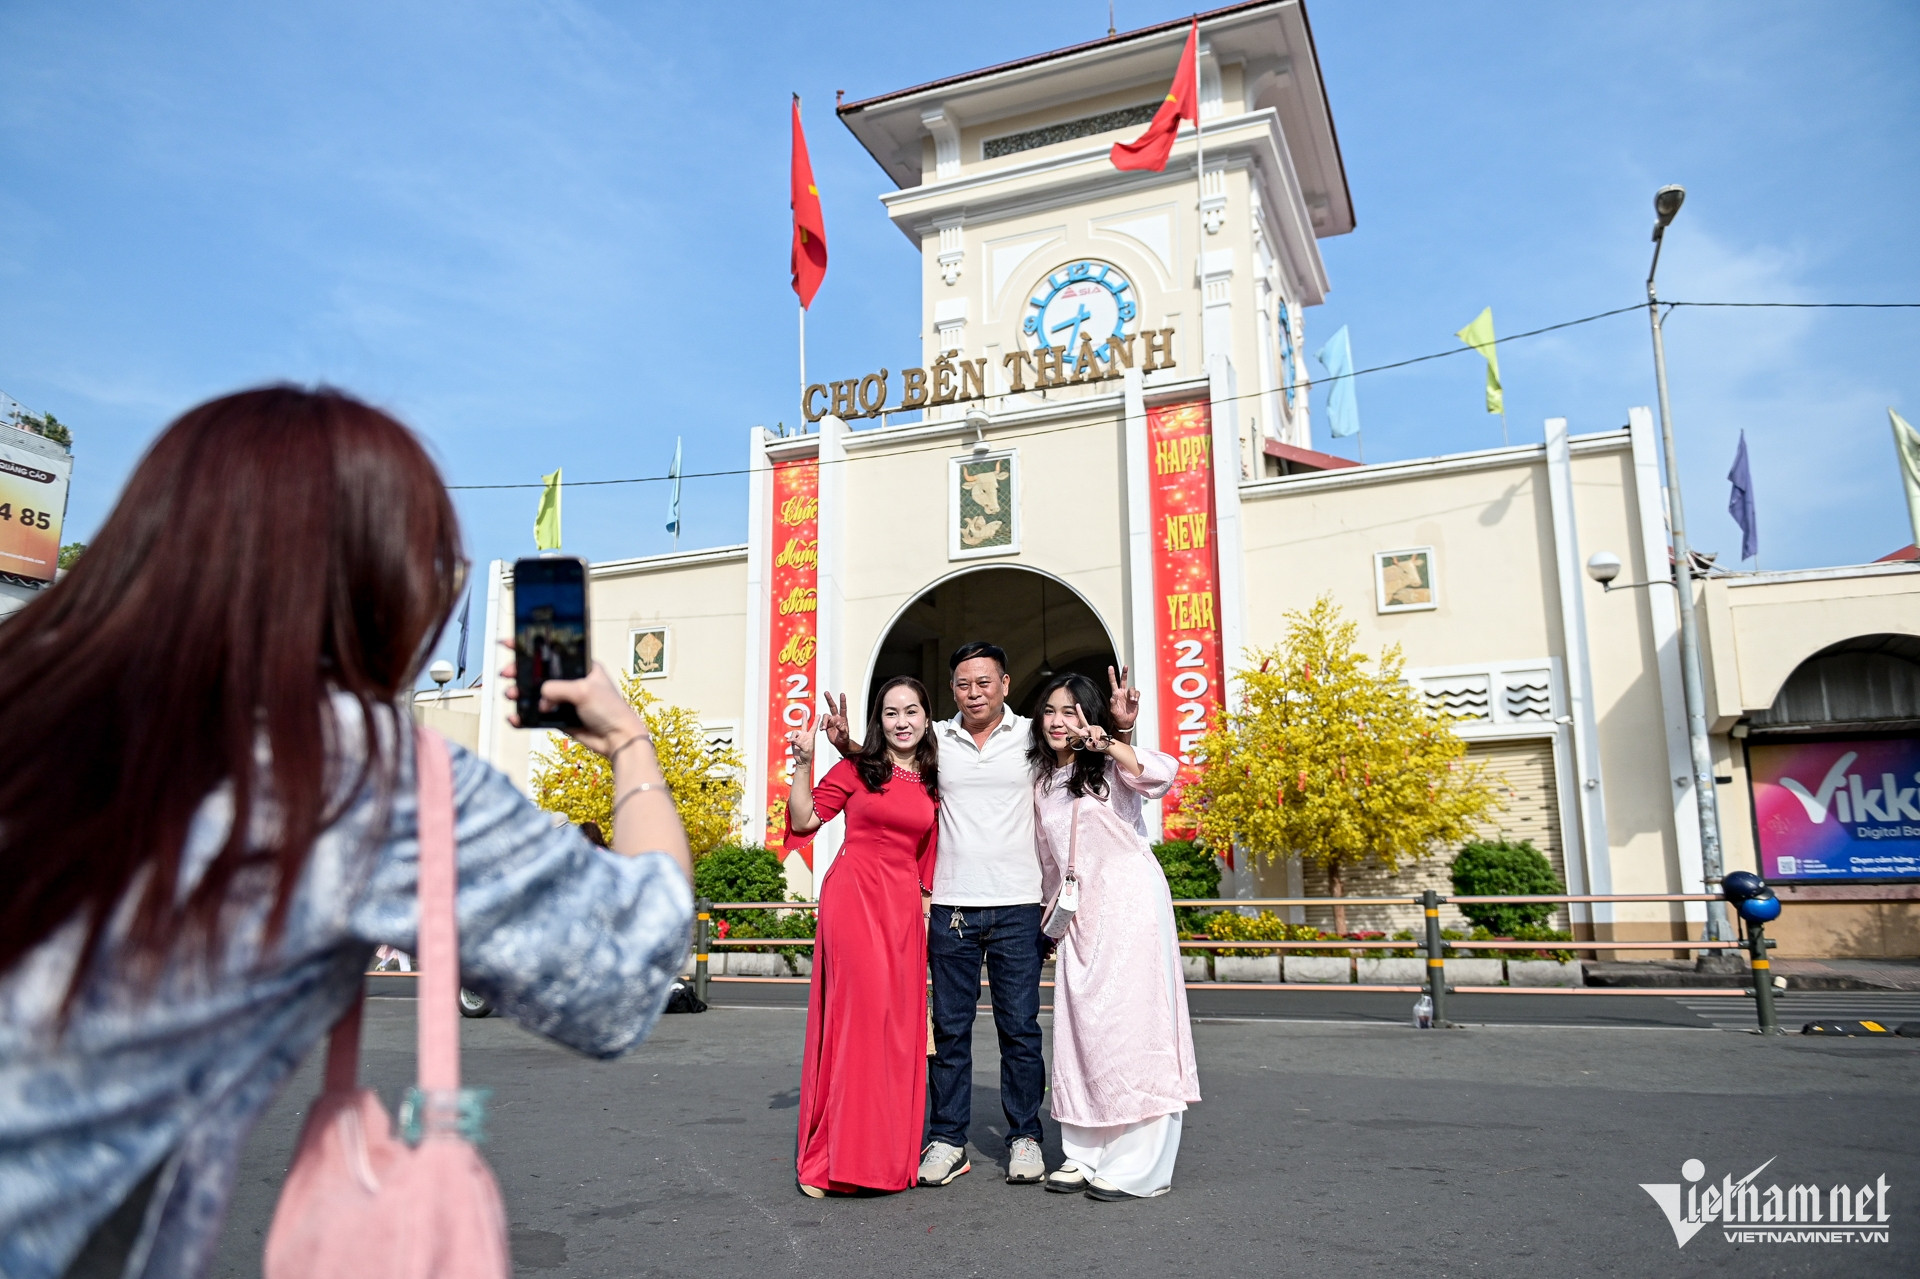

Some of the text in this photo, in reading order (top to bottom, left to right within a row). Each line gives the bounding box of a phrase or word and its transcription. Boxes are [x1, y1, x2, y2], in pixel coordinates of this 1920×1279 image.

[803, 328, 1176, 422] CHỢ BẾN THÀNH
[1156, 434, 1212, 476] HAPPY
[20, 508, 51, 530] 85
[1167, 512, 1208, 551] NEW
[1167, 592, 1216, 631] YEAR
[1172, 639, 1209, 766] 2025
[1857, 826, 1901, 840] Digital
